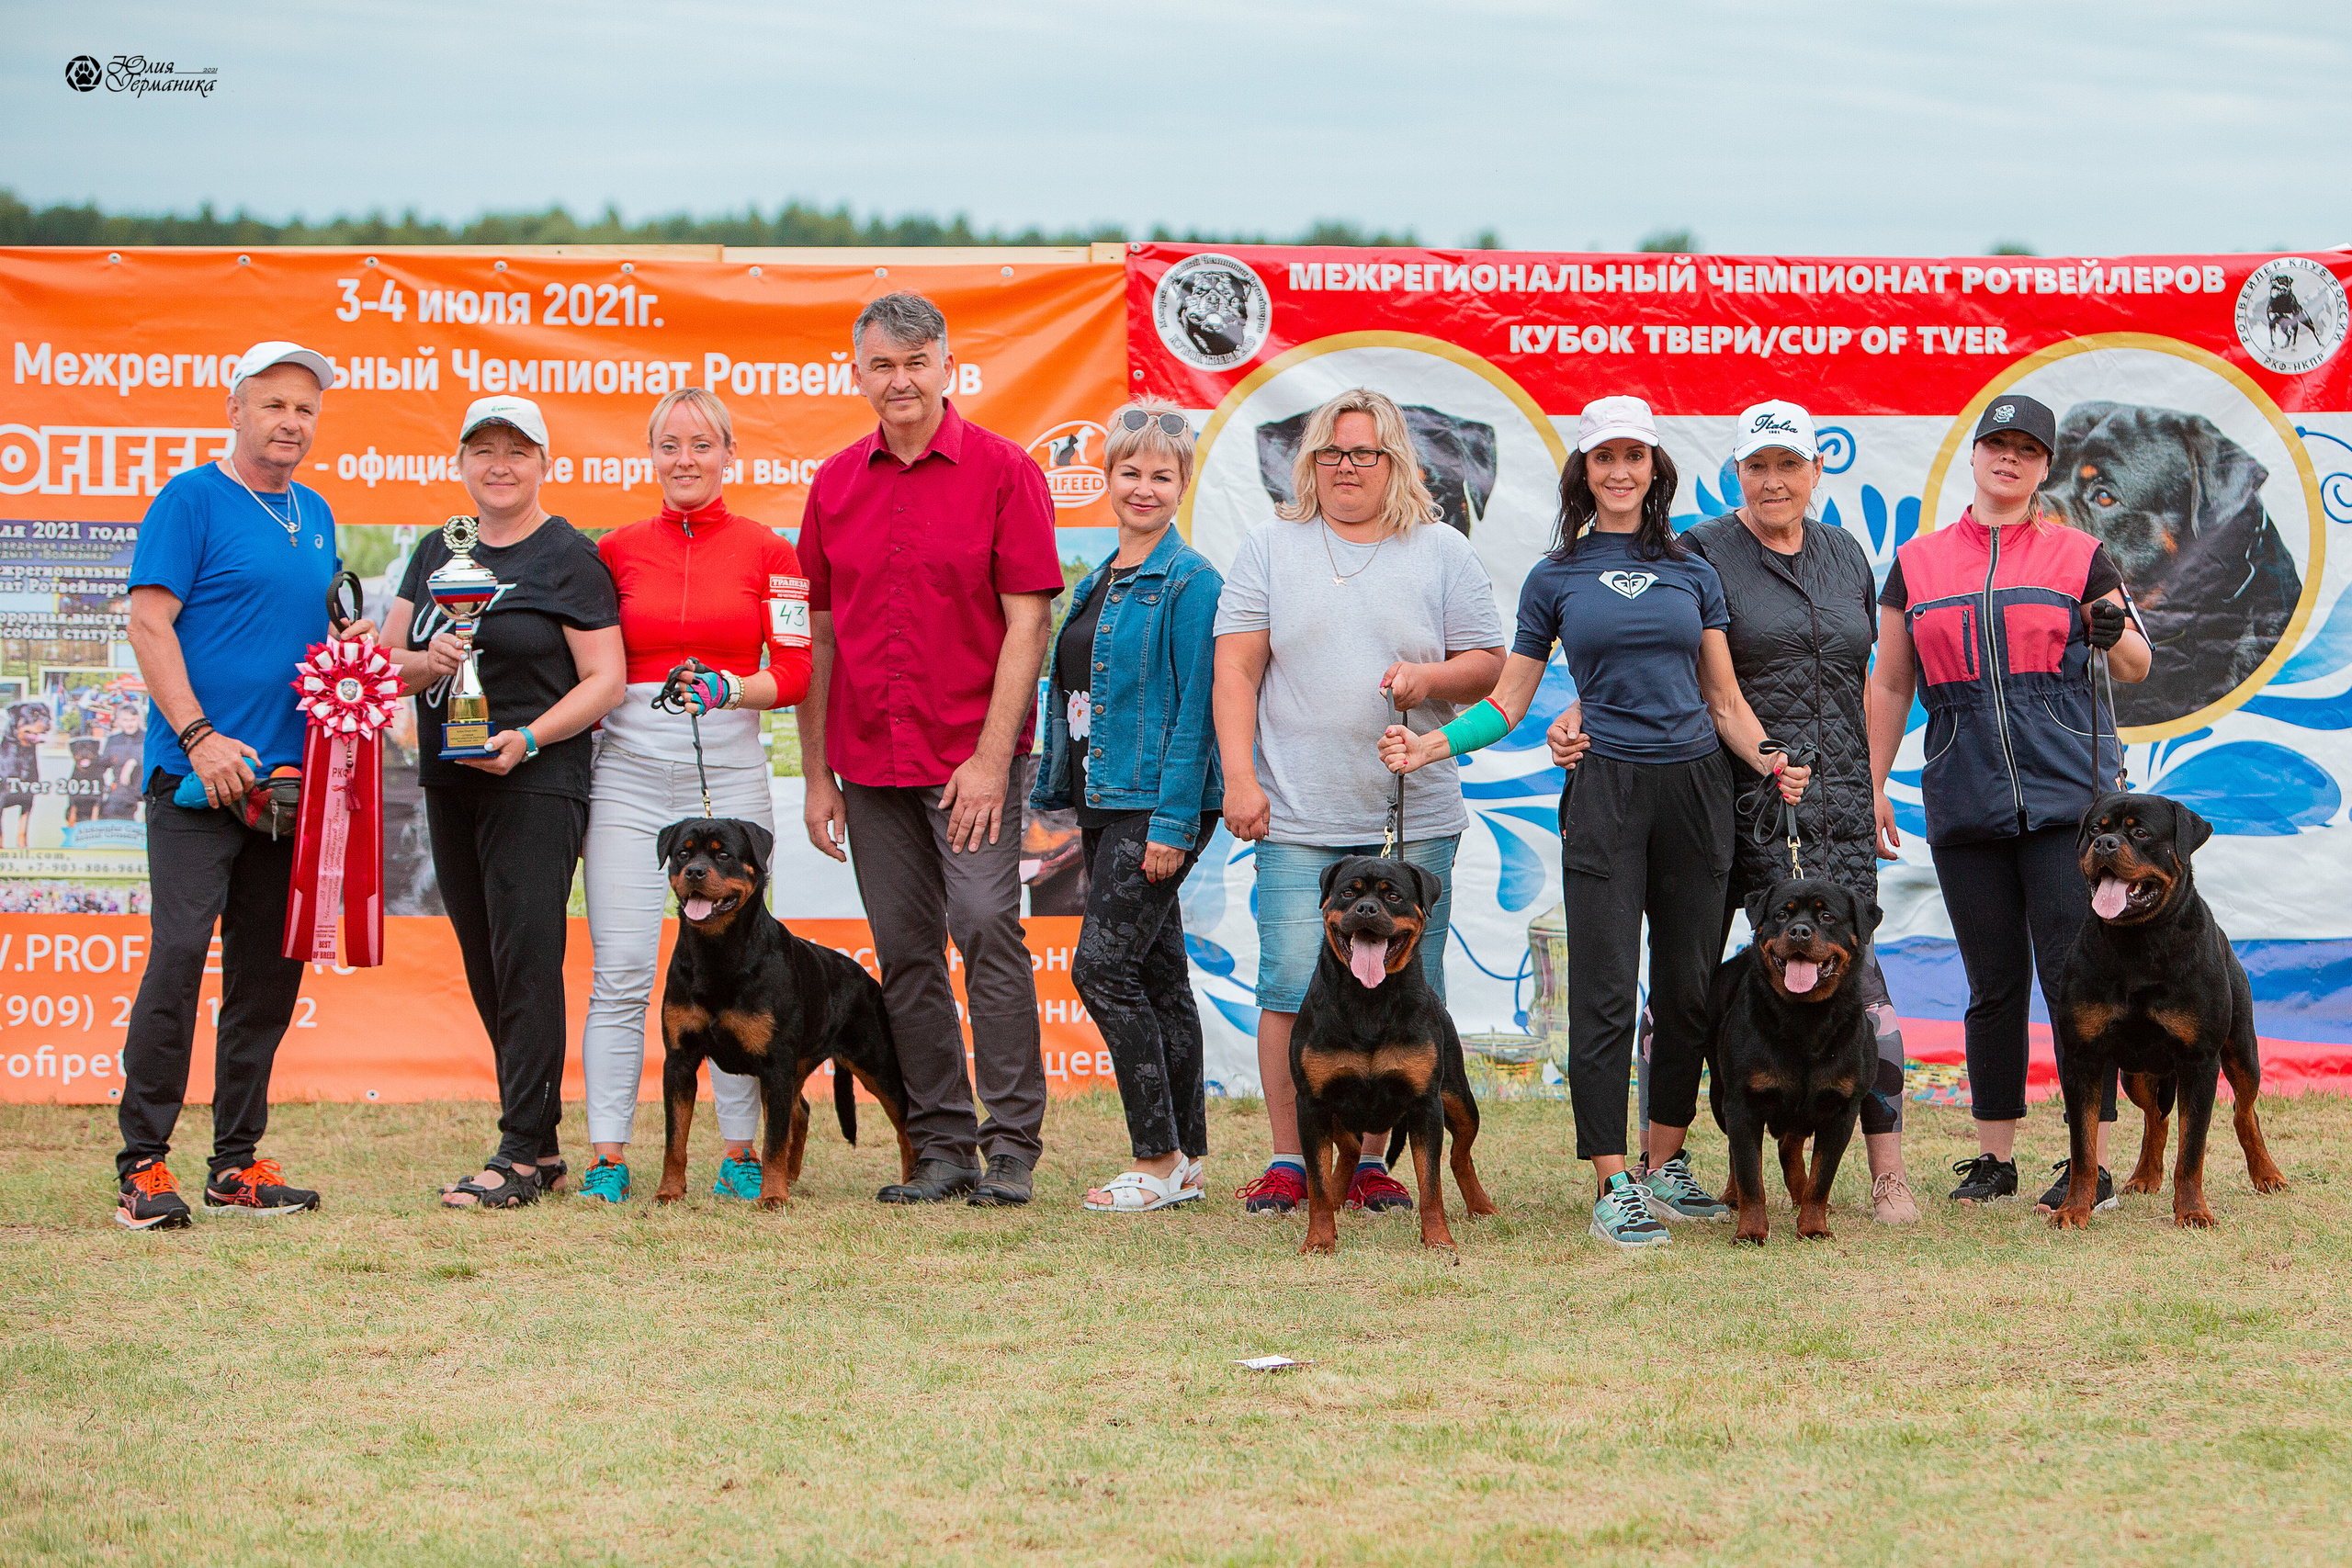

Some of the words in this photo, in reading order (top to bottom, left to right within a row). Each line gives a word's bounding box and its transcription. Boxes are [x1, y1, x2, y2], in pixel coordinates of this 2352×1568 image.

[1289, 256, 1697, 293] МЕЖРЕГИОНАЛЬНЫЙ
[1707, 265, 1952, 294] ЧЕМПИОНАТ
[1961, 258, 2227, 294] РОТВЕЙЛЕРОВ
[335, 278, 407, 321] 3-4
[418, 289, 531, 325] июля
[542, 283, 665, 327] 2021г.
[2236, 261, 2280, 344] РОТВЕЙЛЕР
[2289, 258, 2328, 277] КЛУБ
[2329, 278, 2347, 343] РОССИИ
[1509, 325, 1634, 355] КУБОК
[1643, 325, 1851, 358] ТВЕРИ/CUP
[1860, 326, 1908, 355] OF
[1917, 326, 2009, 355] TVER
[14, 342, 439, 397] Межрегиоьный
[451, 348, 691, 393] Чемпионат
[704, 352, 982, 396] Ротвейв
[1750, 413, 1798, 434] Italia
[337, 446, 574, 489] официае
[32, 522, 81, 540] 2021
[88, 526, 139, 543] года
[73, 613, 131, 626] выстав
[780, 604, 805, 627] 43
[62, 628, 128, 644] статусо
[6, 778, 51, 795] Tver
[56, 778, 101, 795] 2021
[319, 940, 331, 949] BEST
[0, 994, 95, 1032] 909)
